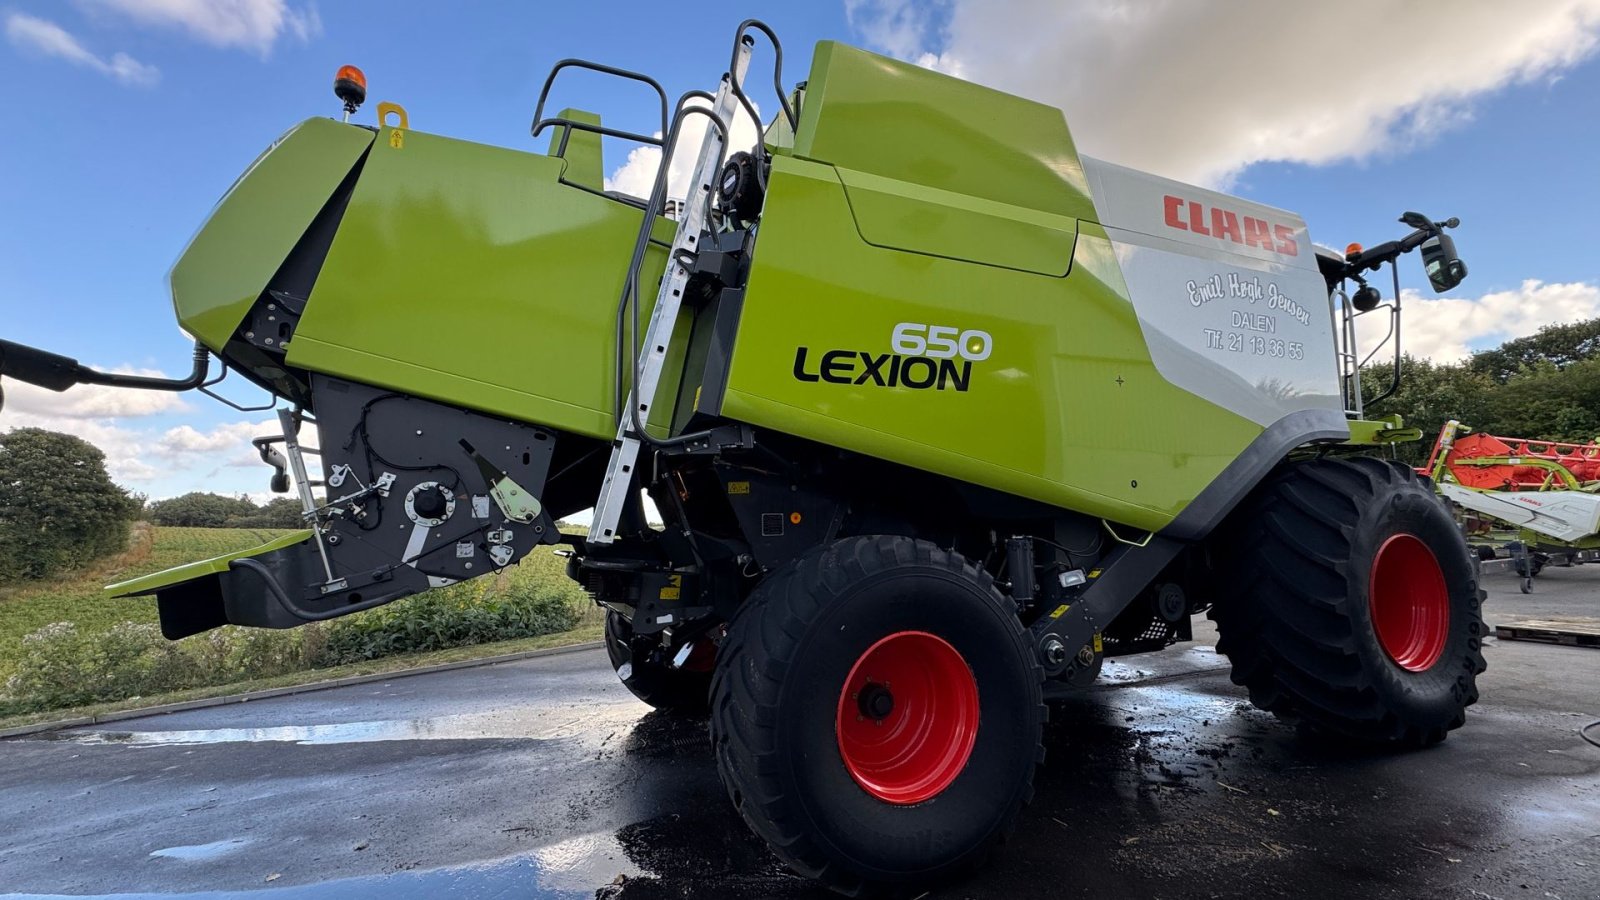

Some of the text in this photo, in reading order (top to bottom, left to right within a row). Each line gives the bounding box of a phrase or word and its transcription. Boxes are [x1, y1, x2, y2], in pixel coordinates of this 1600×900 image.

[1163, 195, 1298, 257] CLAAS
[1186, 273, 1311, 326] Emil Høgh Jensen
[891, 322, 993, 361] 650
[1231, 310, 1276, 334] DALEN
[1204, 328, 1304, 360] Tlf. 21 13 36 55
[793, 346, 972, 392] LEXION
